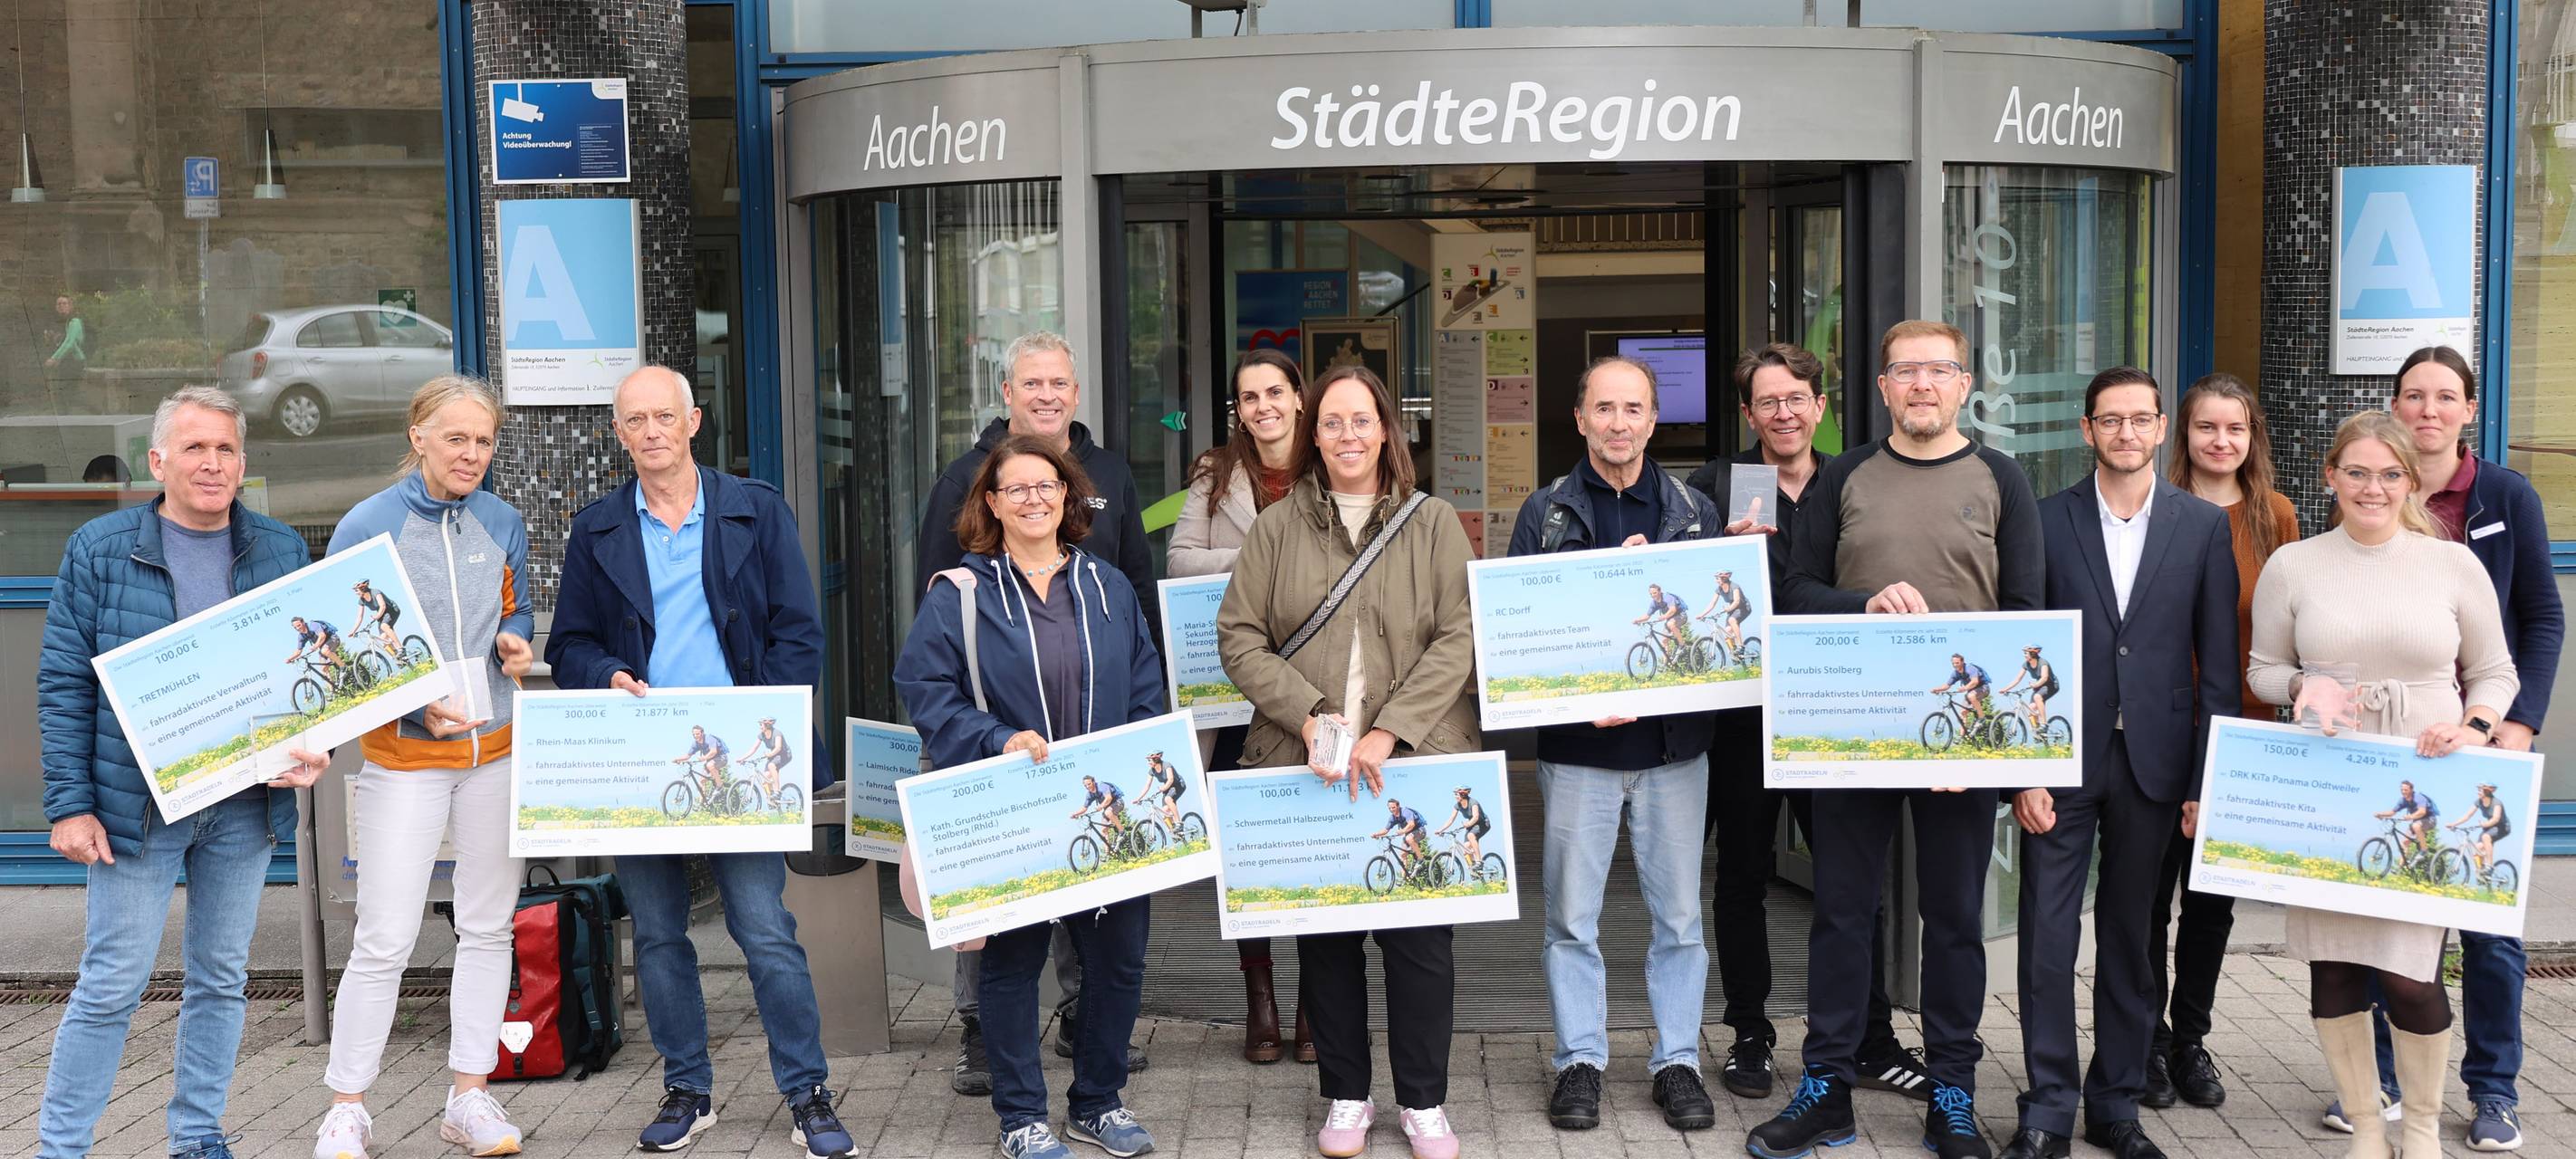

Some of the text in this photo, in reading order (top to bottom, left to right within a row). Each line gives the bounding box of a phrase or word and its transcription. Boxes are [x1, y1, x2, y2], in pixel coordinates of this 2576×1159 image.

[1271, 79, 1742, 159] StädteRegion
[1994, 85, 2123, 148] Aachen
[503, 132, 532, 140] Achtung
[863, 105, 1006, 170] Aachen
[503, 140, 572, 149] Videoüberwachung!
[2341, 192, 2443, 310] A
[1974, 224, 2017, 308] 10
[505, 225, 597, 341] A
[1520, 574, 1562, 587] 100,00 €
[1593, 567, 1643, 580] 10.644 km
[232, 603, 281, 631] 3.814 km
[1495, 605, 1531, 617] RC Dorff
[1497, 624, 1590, 640] fahrradaktivstes Team
[1890, 635, 1946, 644] 12.586 km
[1499, 638, 1610, 656] eine gemeinsame Aktivität
[1815, 637, 1859, 647] 200,00 €
[154, 643, 191, 666] 100,00
[190, 638, 199, 649] €
[1188, 666, 1206, 674] eine
[1786, 666, 1861, 675] Aurubis Stolberg
[138, 670, 200, 704] TRETMÜHLEN
[1787, 689, 1923, 698] fahrradaktivstes Unternehmen
[149, 669, 268, 728] fahrradaktivste Verwaltung
[157, 685, 272, 743] eine gemeinsame Aktivität
[564, 709, 606, 719] 300,00 €
[635, 707, 687, 716] 21.877 km
[1809, 707, 1866, 716] gemeinsame
[1868, 705, 1906, 714] Aktivität
[536, 737, 625, 746] Rhein-Maas Klinikum
[889, 742, 918, 753] 300,00
[2263, 743, 2309, 757] 150,00 €
[535, 759, 666, 769] fahrradaktivstes Unternehmen
[866, 761, 898, 772] Laimisch
[2345, 753, 2398, 768] 4.249 km
[1024, 764, 1058, 780] 17.905
[1059, 759, 1075, 771] km
[555, 777, 610, 787] gemeinsame
[612, 775, 649, 783] Aktivität
[2229, 770, 2360, 794] DRK KiTa Panama Oidtweiler
[951, 781, 985, 799] 200,00
[987, 780, 995, 789] €
[1259, 788, 1300, 799] 100,00 €
[865, 794, 881, 802] eine
[2225, 793, 2316, 813] fahrradaktivste Kita
[929, 790, 1068, 833] Kath. Grundschule Bischofstraße
[1235, 811, 1353, 829] Schwermetall Halbzeugwerk
[2224, 811, 2347, 835] eine gemeinsame Aktivität
[932, 818, 999, 843] Stolberg (Rhld.)
[935, 825, 1030, 857] fahrradaktivste Schule
[1236, 835, 1364, 851] fahrradaktivstes Unternehmen
[938, 861, 957, 872] eine
[959, 848, 1014, 868] gemeinsame
[1014, 837, 1052, 853] Aktivität
[1238, 859, 1256, 867] eine
[1258, 856, 1312, 867] gemeinsame
[1313, 852, 1350, 862] Aktivität
